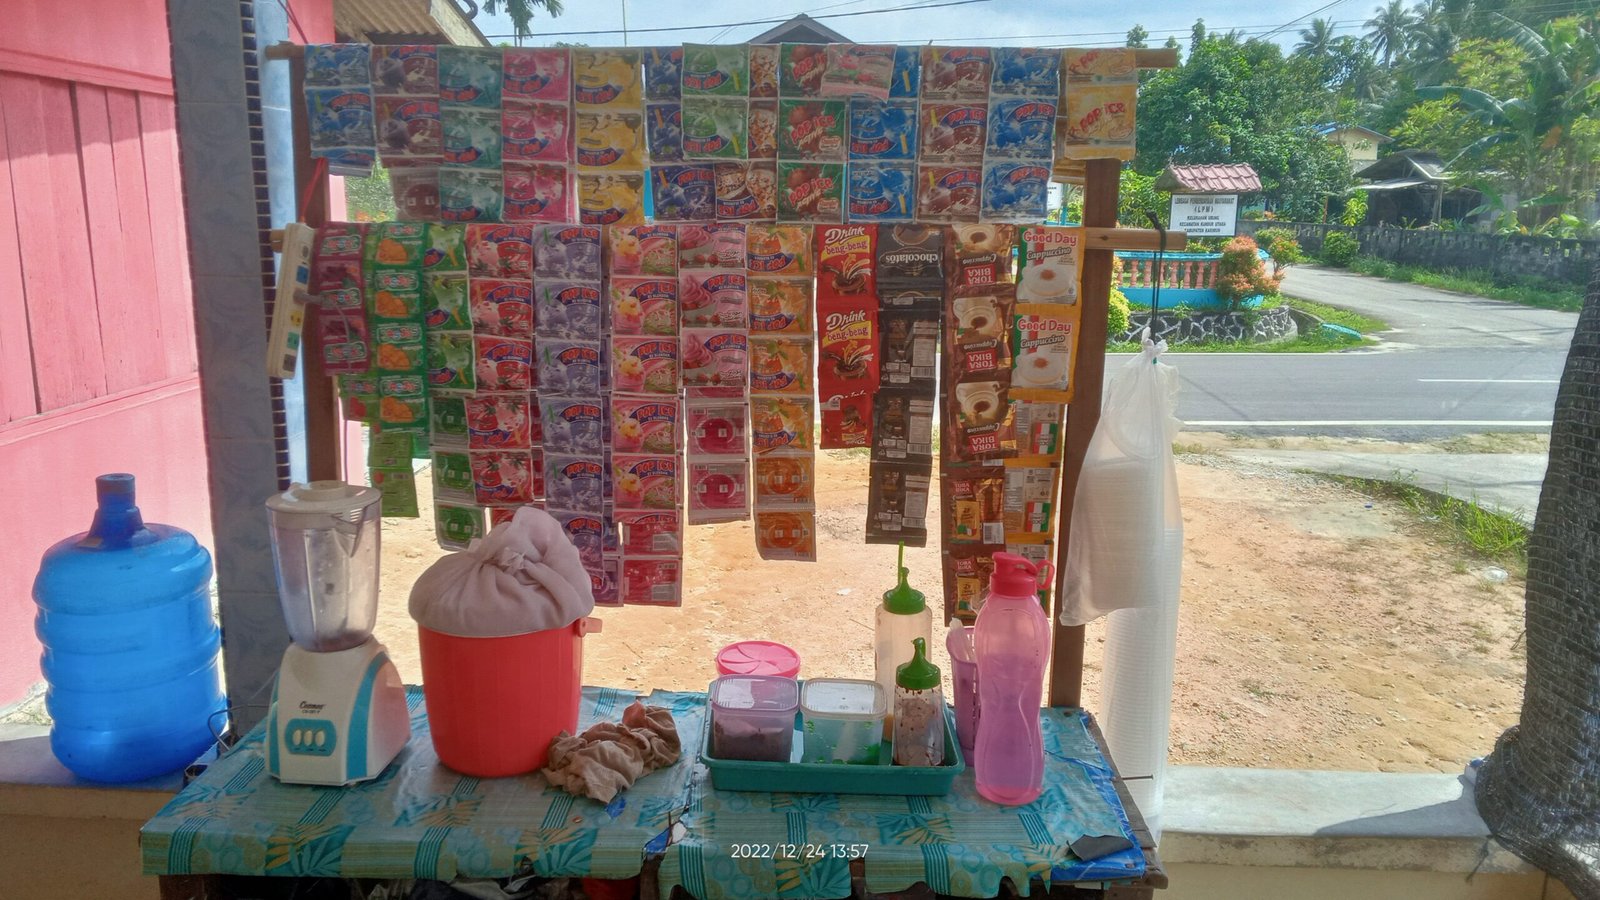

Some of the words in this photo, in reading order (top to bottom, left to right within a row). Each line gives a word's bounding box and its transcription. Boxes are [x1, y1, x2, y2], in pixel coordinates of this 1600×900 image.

[1080, 107, 1102, 131] POP
[791, 120, 812, 145] POP
[789, 182, 811, 207] POP
[740, 200, 757, 214] POP
[825, 227, 865, 244] Drink
[1023, 231, 1052, 244] Good
[1056, 232, 1078, 247] Day
[826, 240, 868, 256] beng-beng
[1027, 248, 1072, 262] Cappuccino
[767, 256, 786, 270] POP
[968, 266, 992, 277] BIKA
[708, 274, 726, 290] POP
[968, 275, 994, 286] TORA
[638, 282, 657, 297] POP
[826, 308, 866, 330] Drink
[828, 326, 869, 342] beng-beng
[1017, 318, 1045, 332] Good
[1049, 320, 1073, 336] Day
[710, 335, 728, 349] POP
[1020, 335, 1066, 350] Cappuccino
[639, 342, 658, 358] POP
[969, 348, 993, 359] BIKA
[969, 358, 995, 370] TORA
[638, 407, 656, 421] POP
[768, 435, 787, 448] POP
[971, 436, 995, 445] BIKA
[972, 444, 997, 452] TORA
[637, 462, 656, 476] POP
